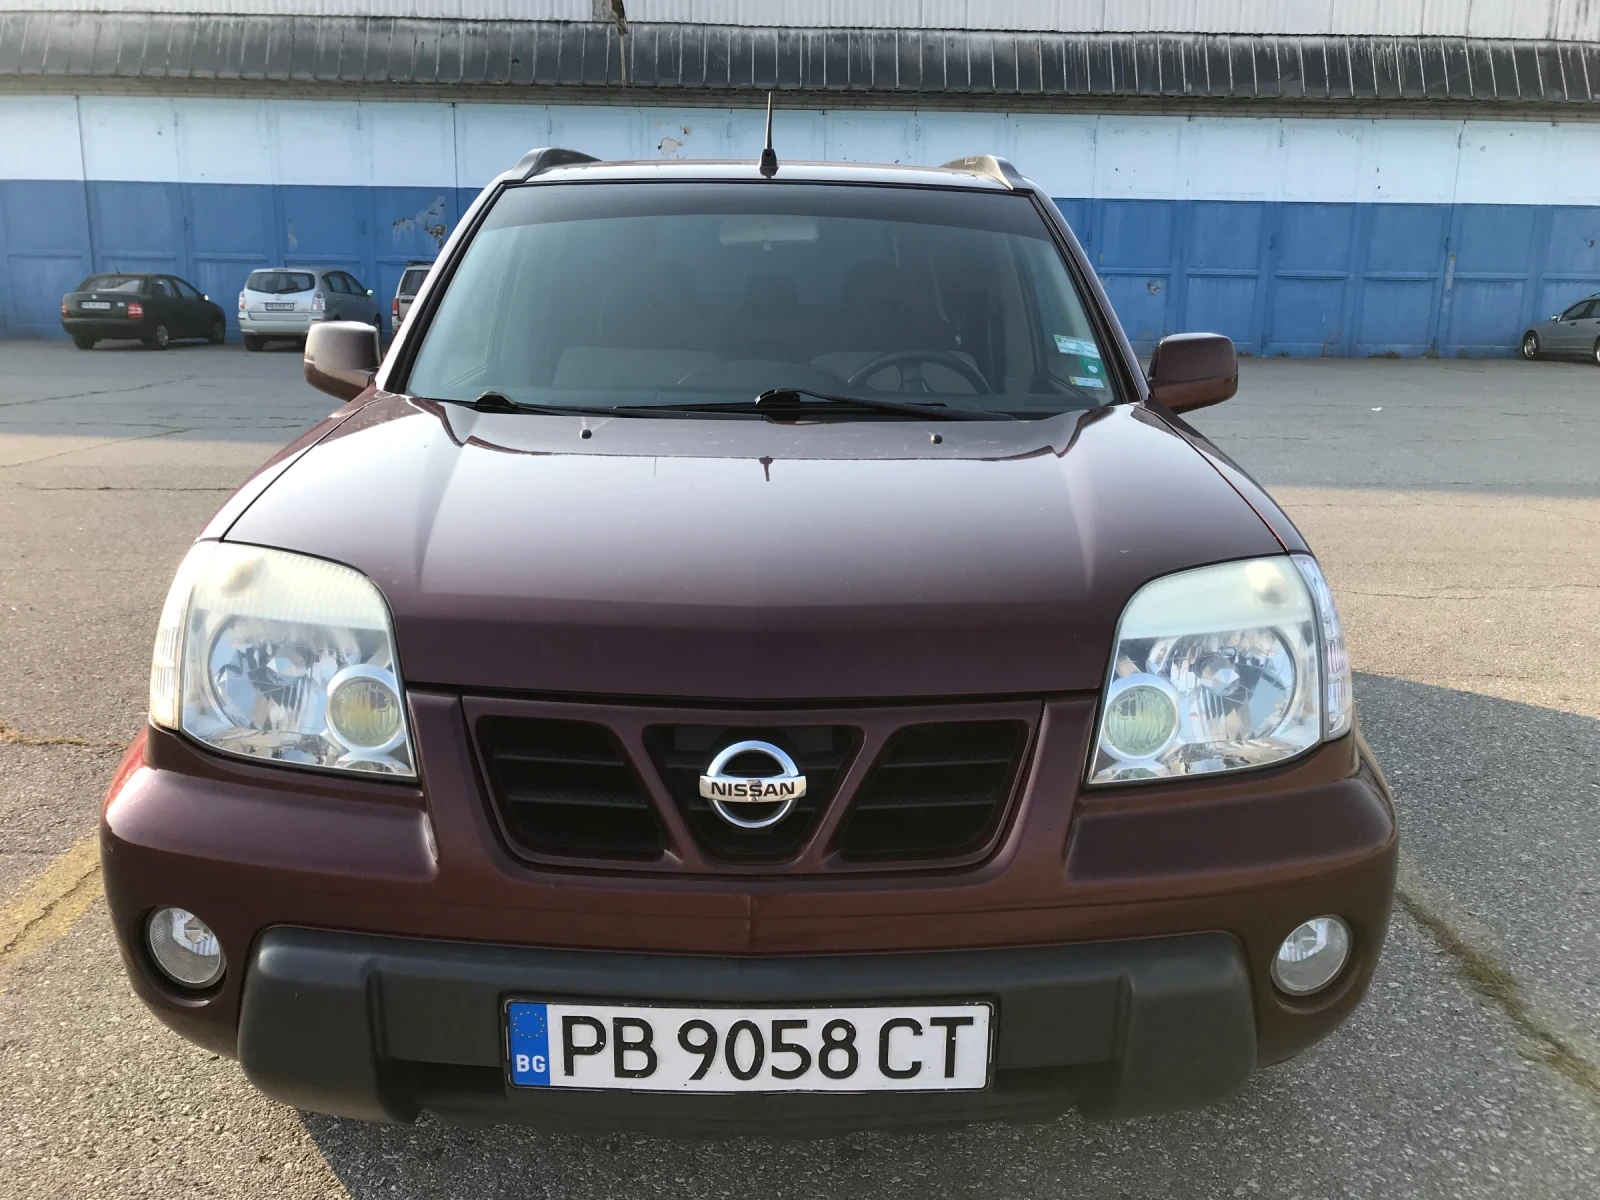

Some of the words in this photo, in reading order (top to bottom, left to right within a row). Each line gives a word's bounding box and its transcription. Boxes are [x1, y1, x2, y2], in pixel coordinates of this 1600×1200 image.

[711, 781, 795, 797] NISSAN
[561, 1015, 658, 1079] PB
[677, 1018, 859, 1081] 9058
[878, 1016, 974, 1079] CT
[516, 1054, 546, 1073] BG
